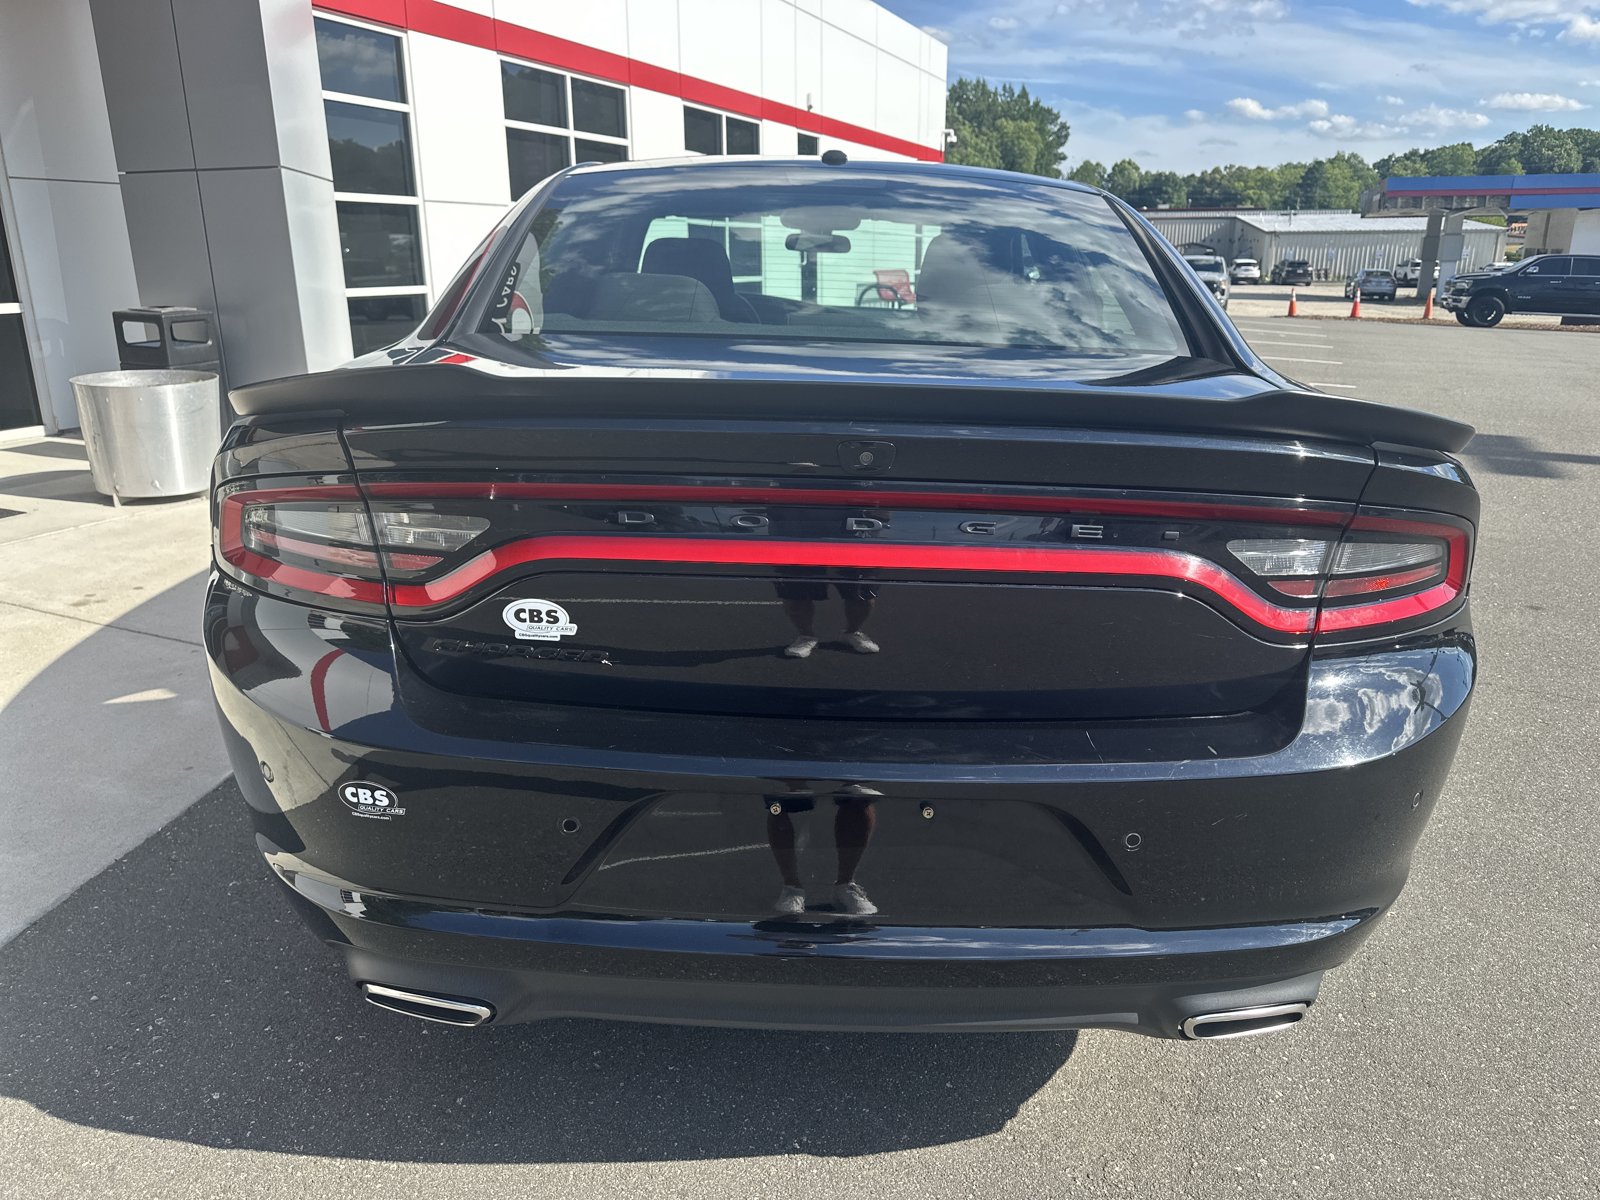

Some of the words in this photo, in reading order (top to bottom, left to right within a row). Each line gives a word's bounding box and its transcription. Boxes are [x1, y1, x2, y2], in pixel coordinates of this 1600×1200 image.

[618, 510, 1104, 539] DODGE
[514, 608, 560, 624] CBS
[345, 786, 389, 806] CBS
